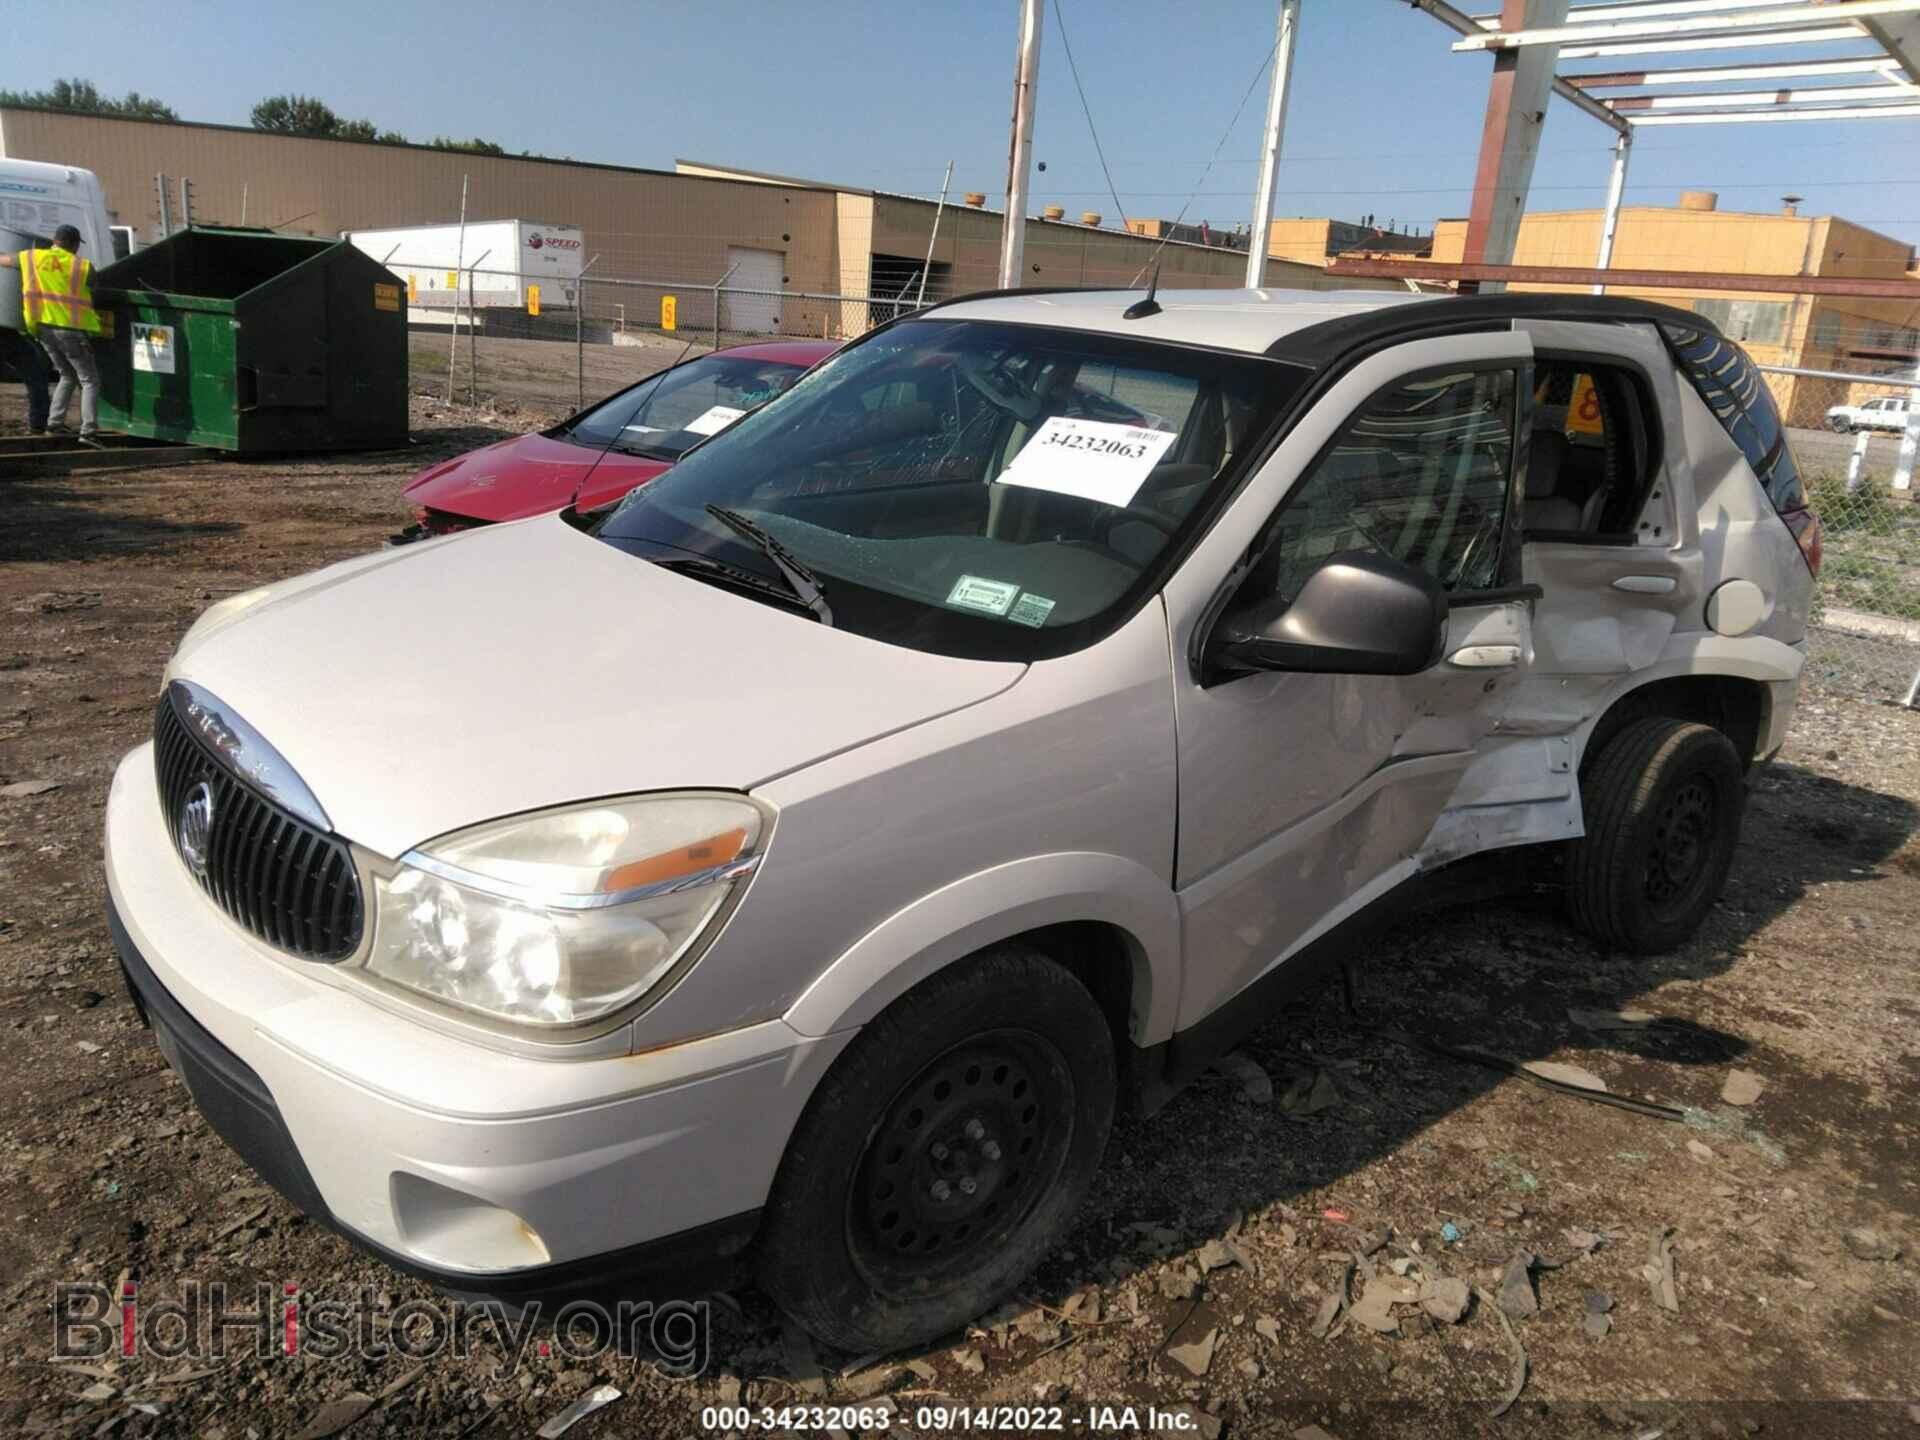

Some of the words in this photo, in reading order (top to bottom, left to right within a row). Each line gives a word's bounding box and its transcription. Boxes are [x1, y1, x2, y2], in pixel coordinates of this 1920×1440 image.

[544, 237, 581, 250] SPEED
[1579, 388, 1601, 421] 8
[1042, 432, 1147, 458] 34232063
